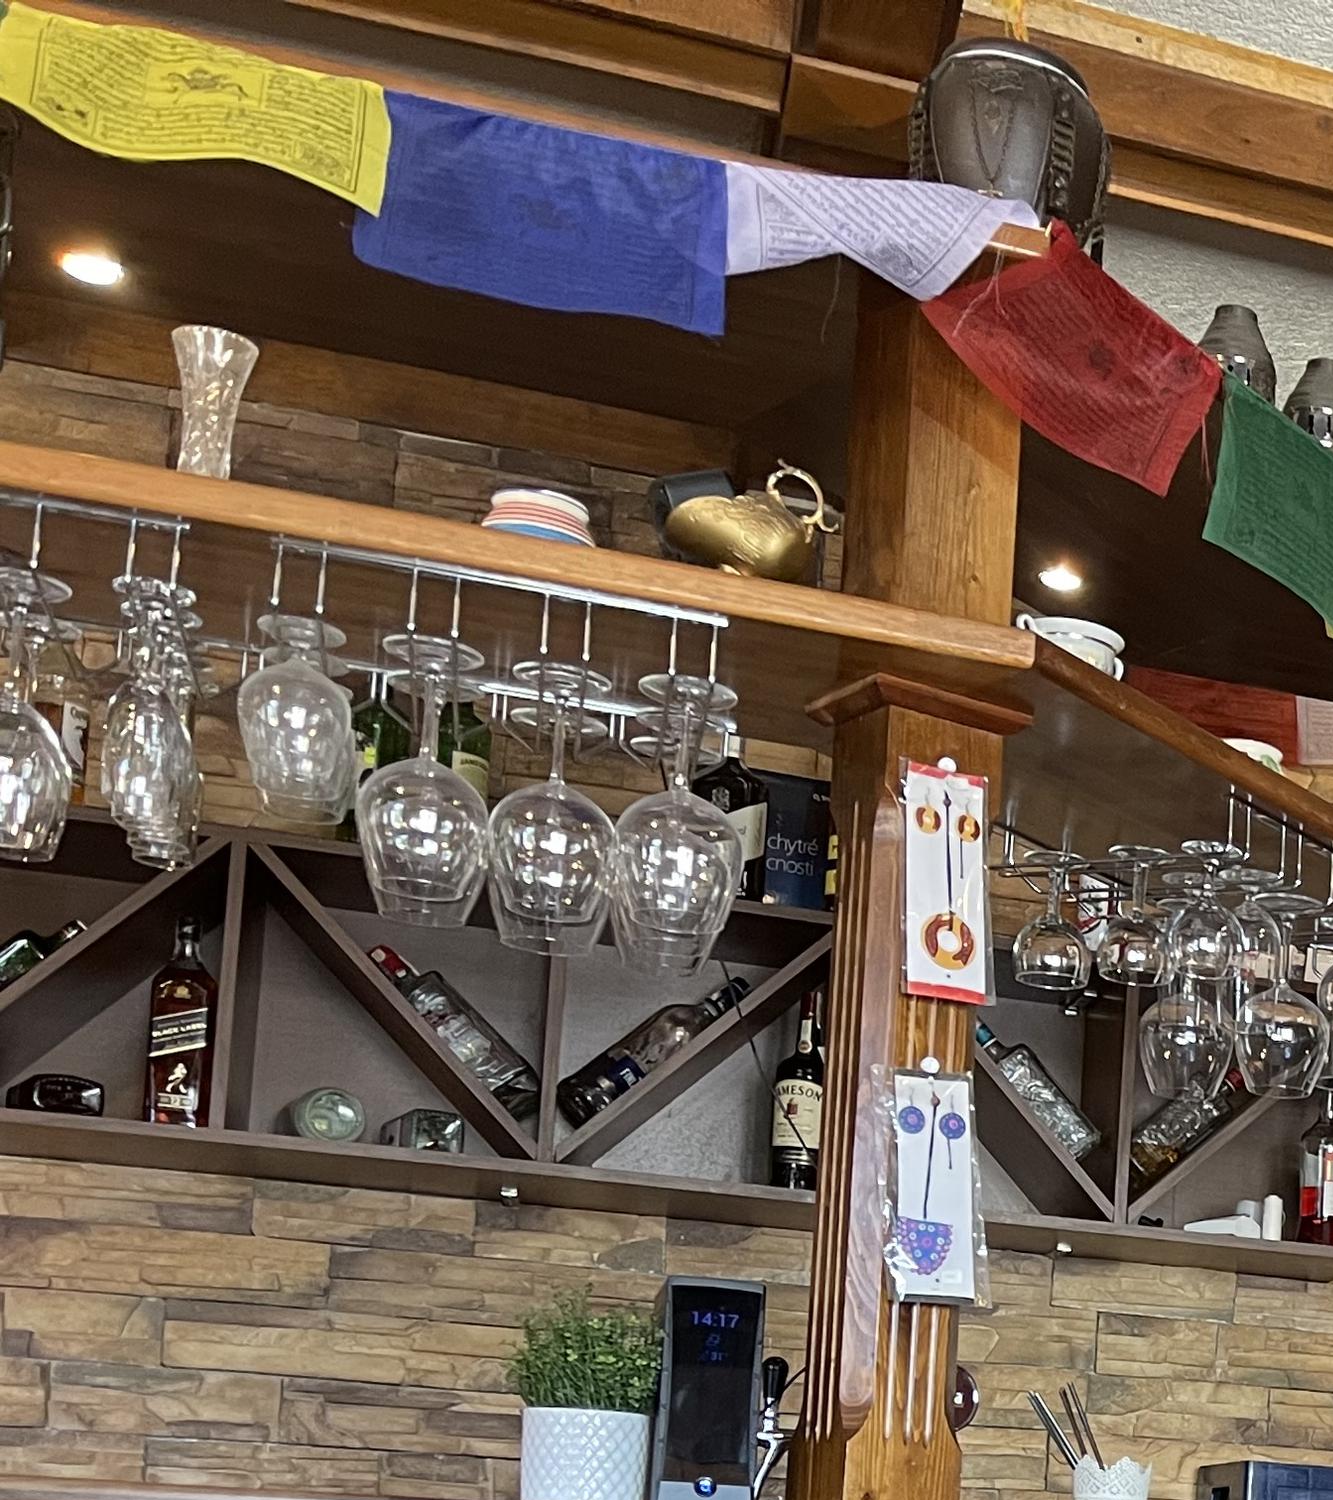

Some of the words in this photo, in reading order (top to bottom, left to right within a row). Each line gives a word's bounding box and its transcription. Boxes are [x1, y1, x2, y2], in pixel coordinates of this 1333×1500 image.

[767, 833, 818, 856] chytré
[776, 1084, 823, 1102] AMESON
[691, 1311, 740, 1328] 14:17
